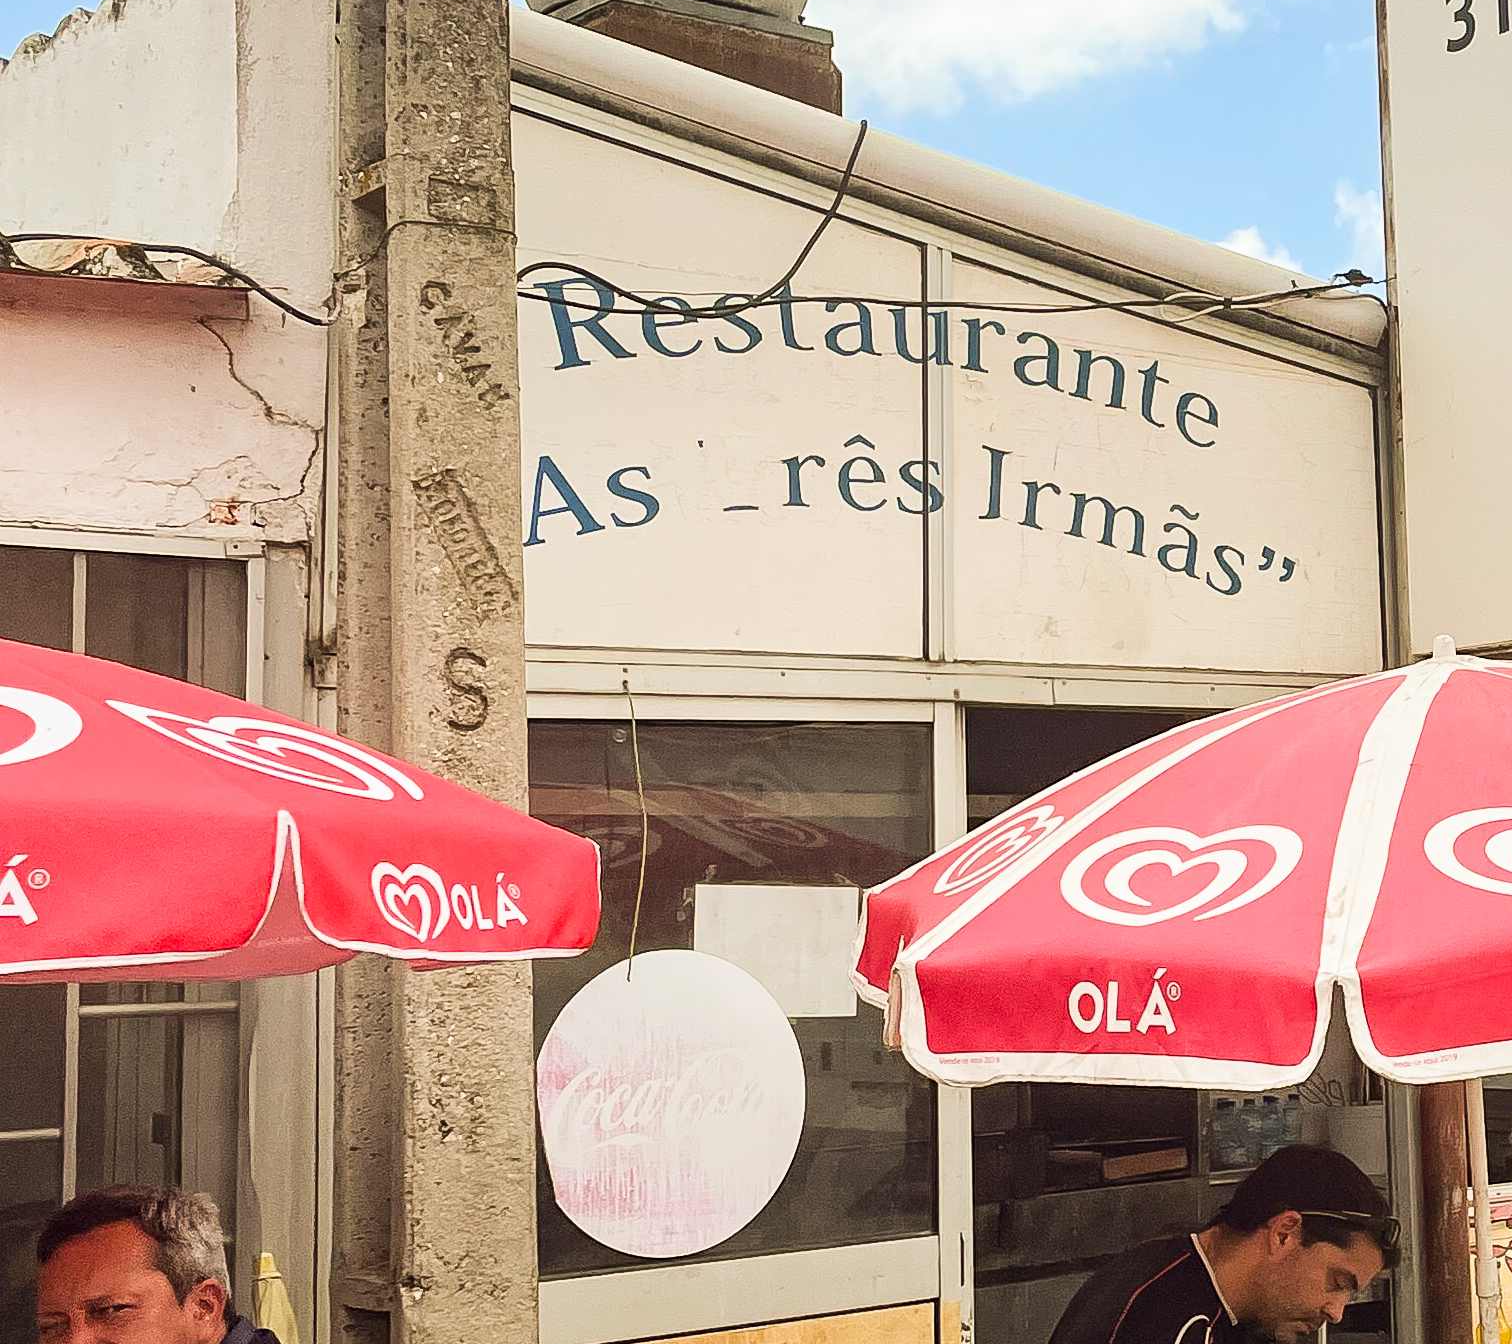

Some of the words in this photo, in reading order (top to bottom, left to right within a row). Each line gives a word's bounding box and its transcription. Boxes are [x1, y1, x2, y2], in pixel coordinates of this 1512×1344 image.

[534, 273, 1220, 449] Restaurante
[523, 455, 661, 548] As
[724, 433, 943, 515] rês
